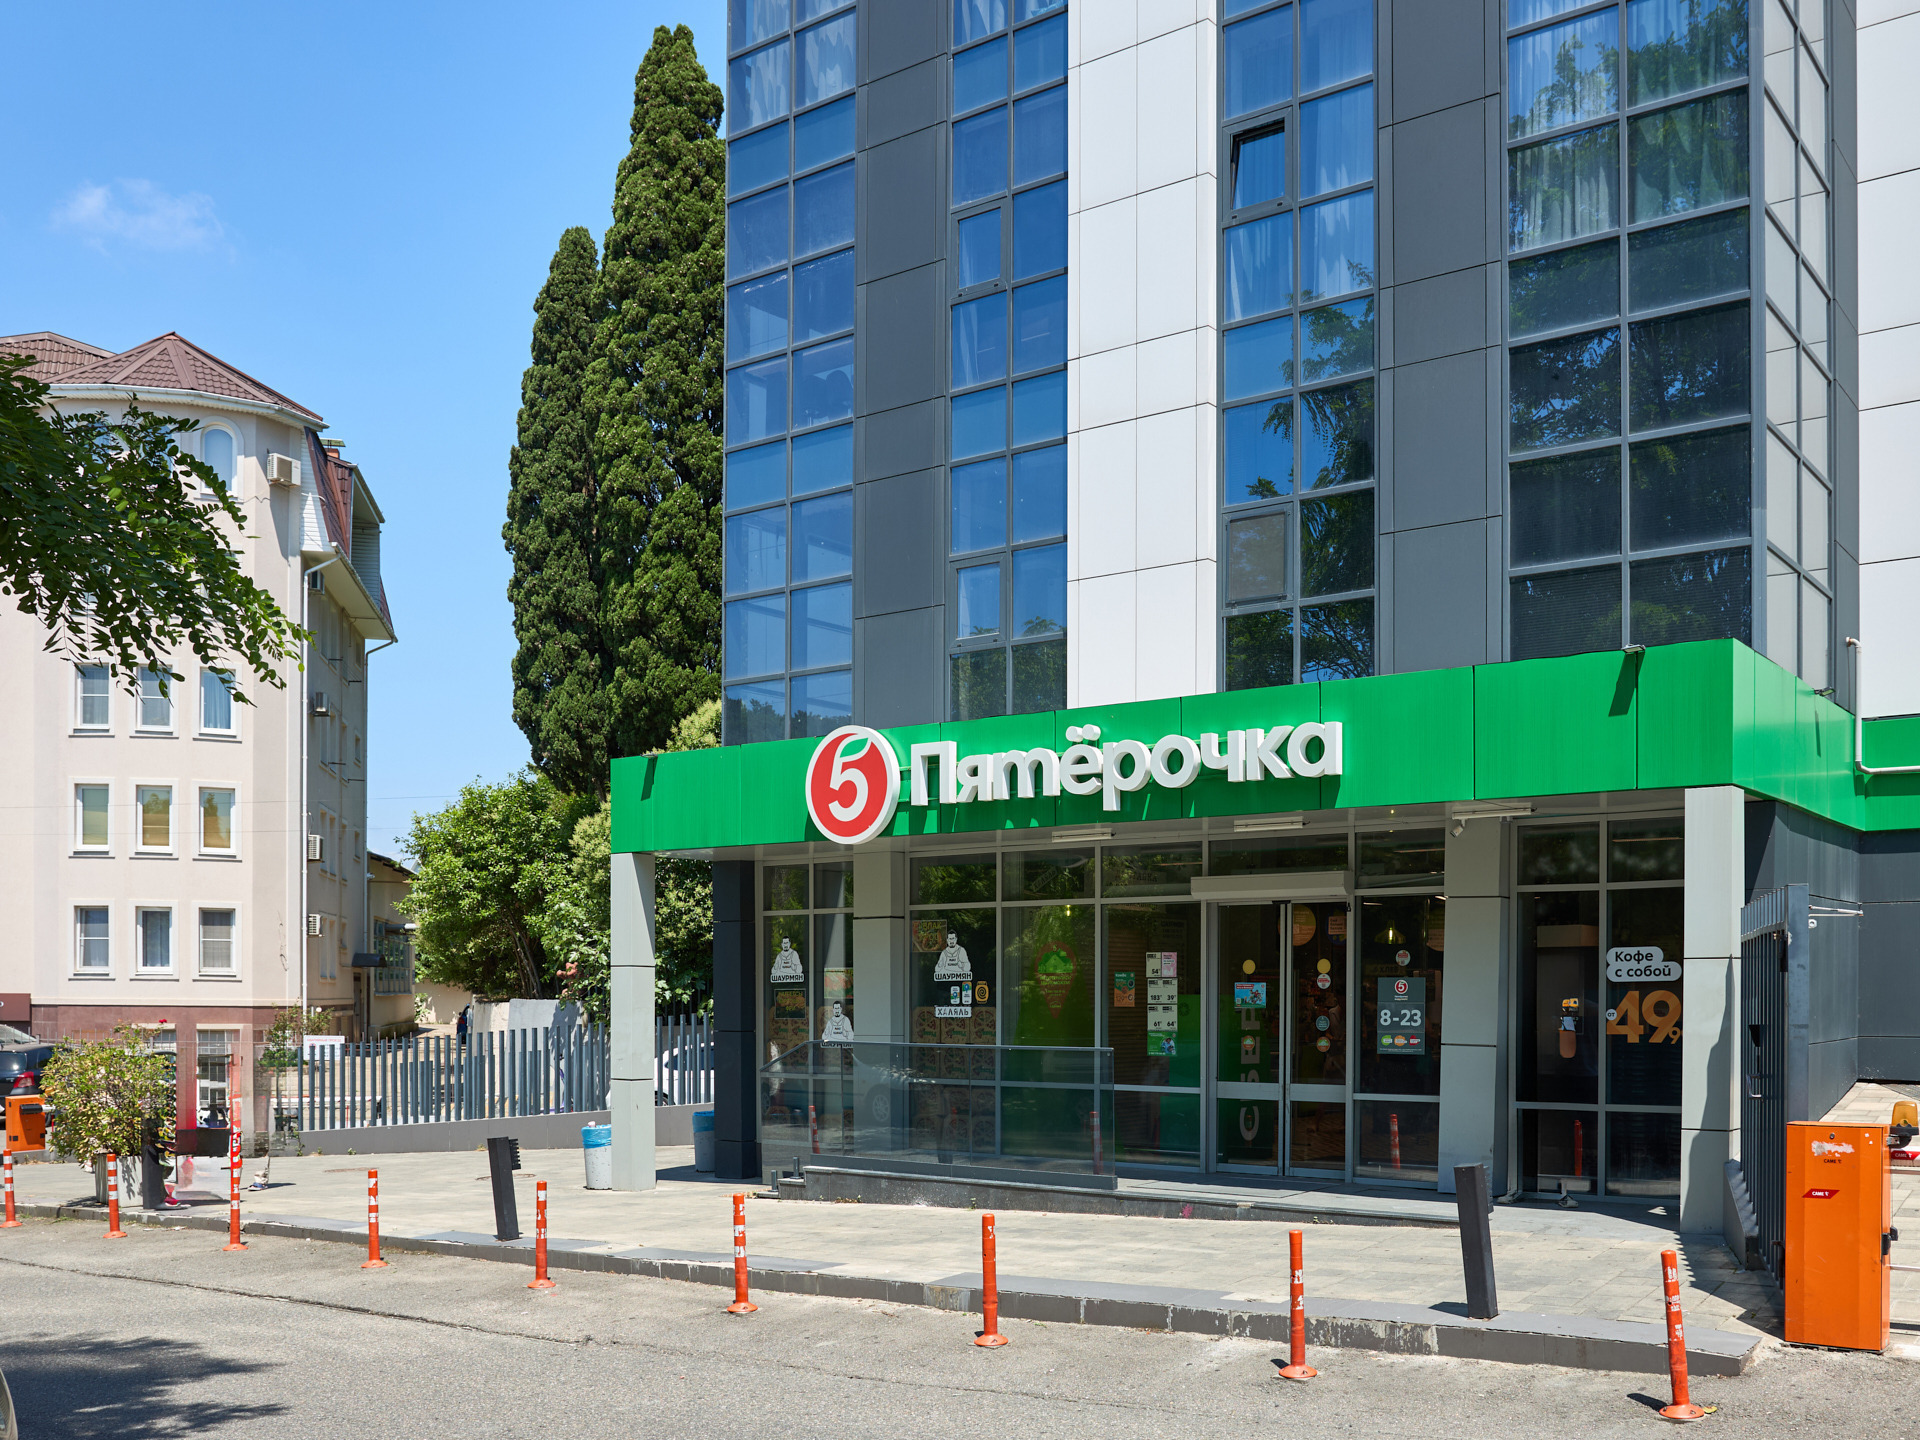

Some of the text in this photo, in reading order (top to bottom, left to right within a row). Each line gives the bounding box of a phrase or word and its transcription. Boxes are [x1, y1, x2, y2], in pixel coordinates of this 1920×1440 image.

[910, 721, 1343, 812] Пятёрочка
[1615, 950, 1654, 964] Кофе
[935, 972, 972, 981] ШАУРМЯН
[1615, 965, 1671, 977] с собой
[771, 974, 804, 982] ШАУРМЯН
[937, 1007, 970, 1017] ХАЛЯЛЬ
[1379, 1009, 1422, 1027] 8-23
[1606, 989, 1682, 1044] 49
